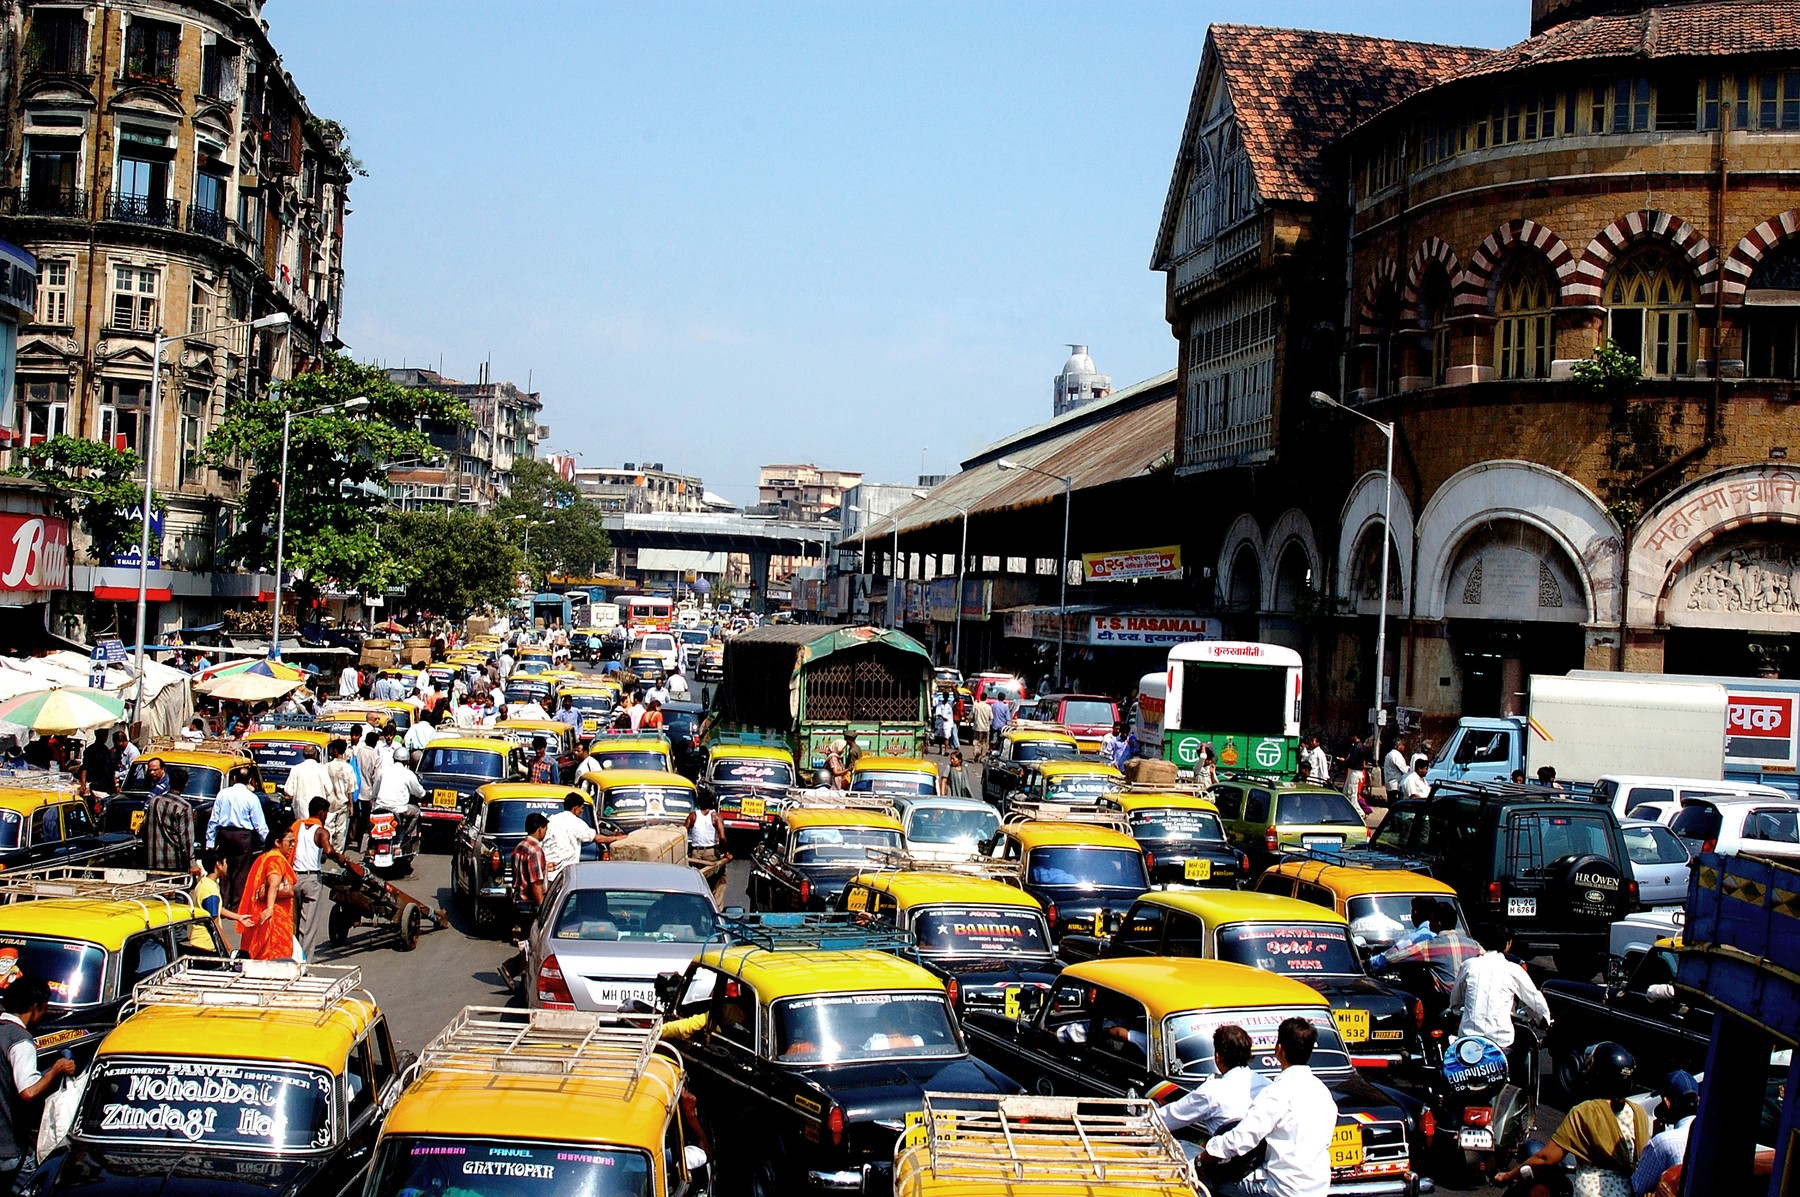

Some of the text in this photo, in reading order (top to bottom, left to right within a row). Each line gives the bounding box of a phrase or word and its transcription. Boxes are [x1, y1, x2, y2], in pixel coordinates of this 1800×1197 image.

[1727, 472, 1800, 505] ज्योति
[2, 518, 66, 587] Bata
[1096, 617, 1206, 632] T. S. HASANALI
[96, 647, 105, 660] P
[953, 923, 1023, 937] BANDRA
[602, 989, 617, 1001] MH
[1338, 1014, 1351, 1023] MH
[166, 1063, 243, 1079] PANVEL
[489, 1147, 534, 1158] PANVEL
[462, 1160, 555, 1179] GHATKOPAR
